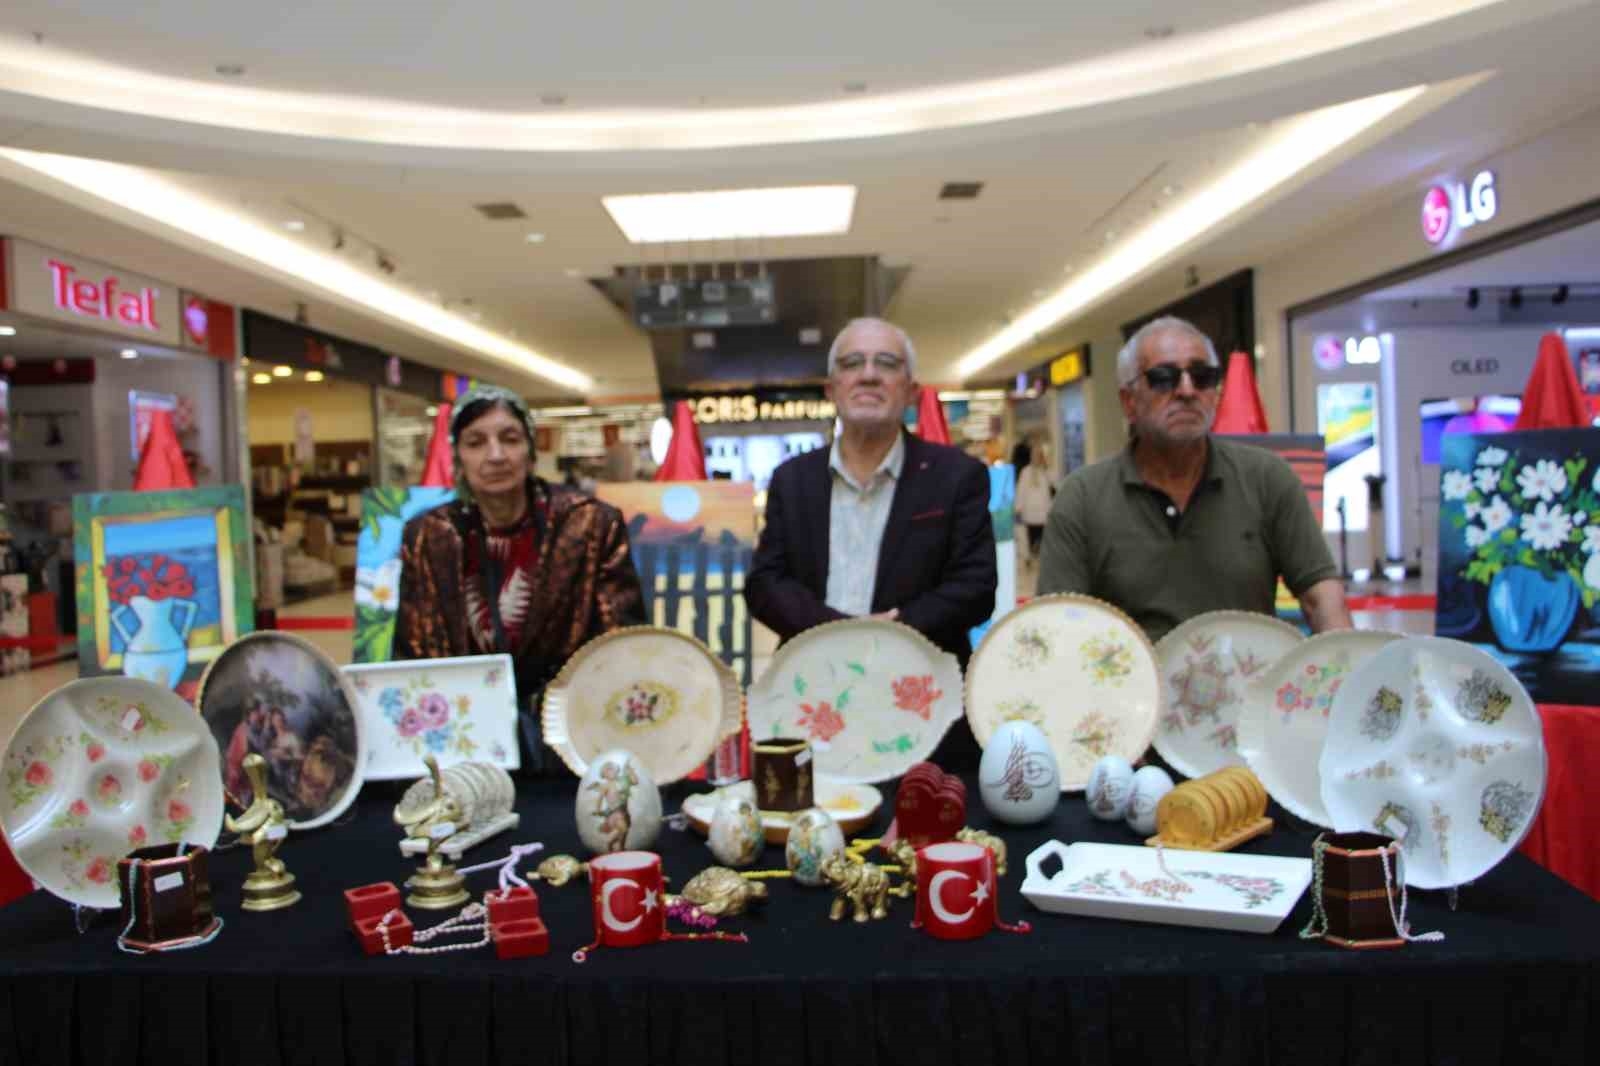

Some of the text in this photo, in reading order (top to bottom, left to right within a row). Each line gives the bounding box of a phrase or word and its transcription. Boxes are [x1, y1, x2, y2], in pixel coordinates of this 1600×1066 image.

[1456, 170, 1496, 228] LG
[46, 258, 161, 331] Tefal
[1345, 336, 1381, 364] LG
[1450, 358, 1500, 375] OLED
